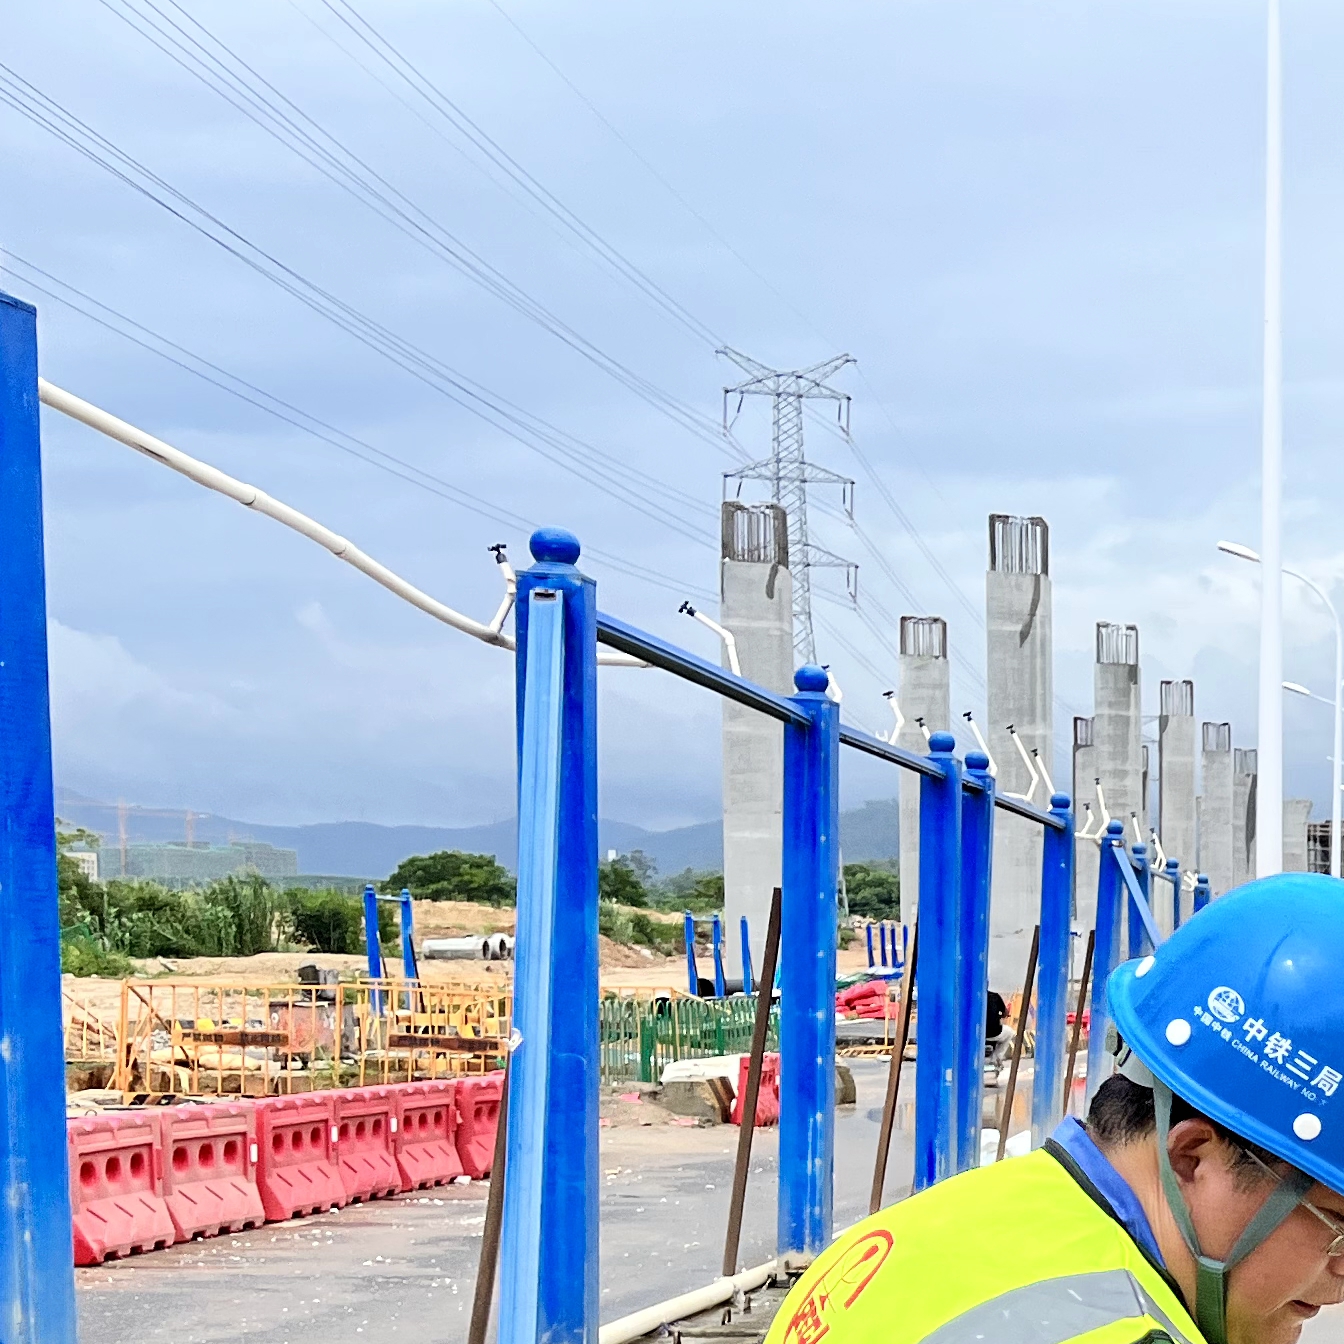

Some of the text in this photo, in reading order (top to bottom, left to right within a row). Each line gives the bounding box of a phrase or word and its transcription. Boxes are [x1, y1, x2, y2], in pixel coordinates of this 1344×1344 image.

[1231, 1039, 1259, 1063] CHINA
[1260, 1059, 1301, 1090] RAILWAY
[1242, 1017, 1343, 1097] 中铁三局
